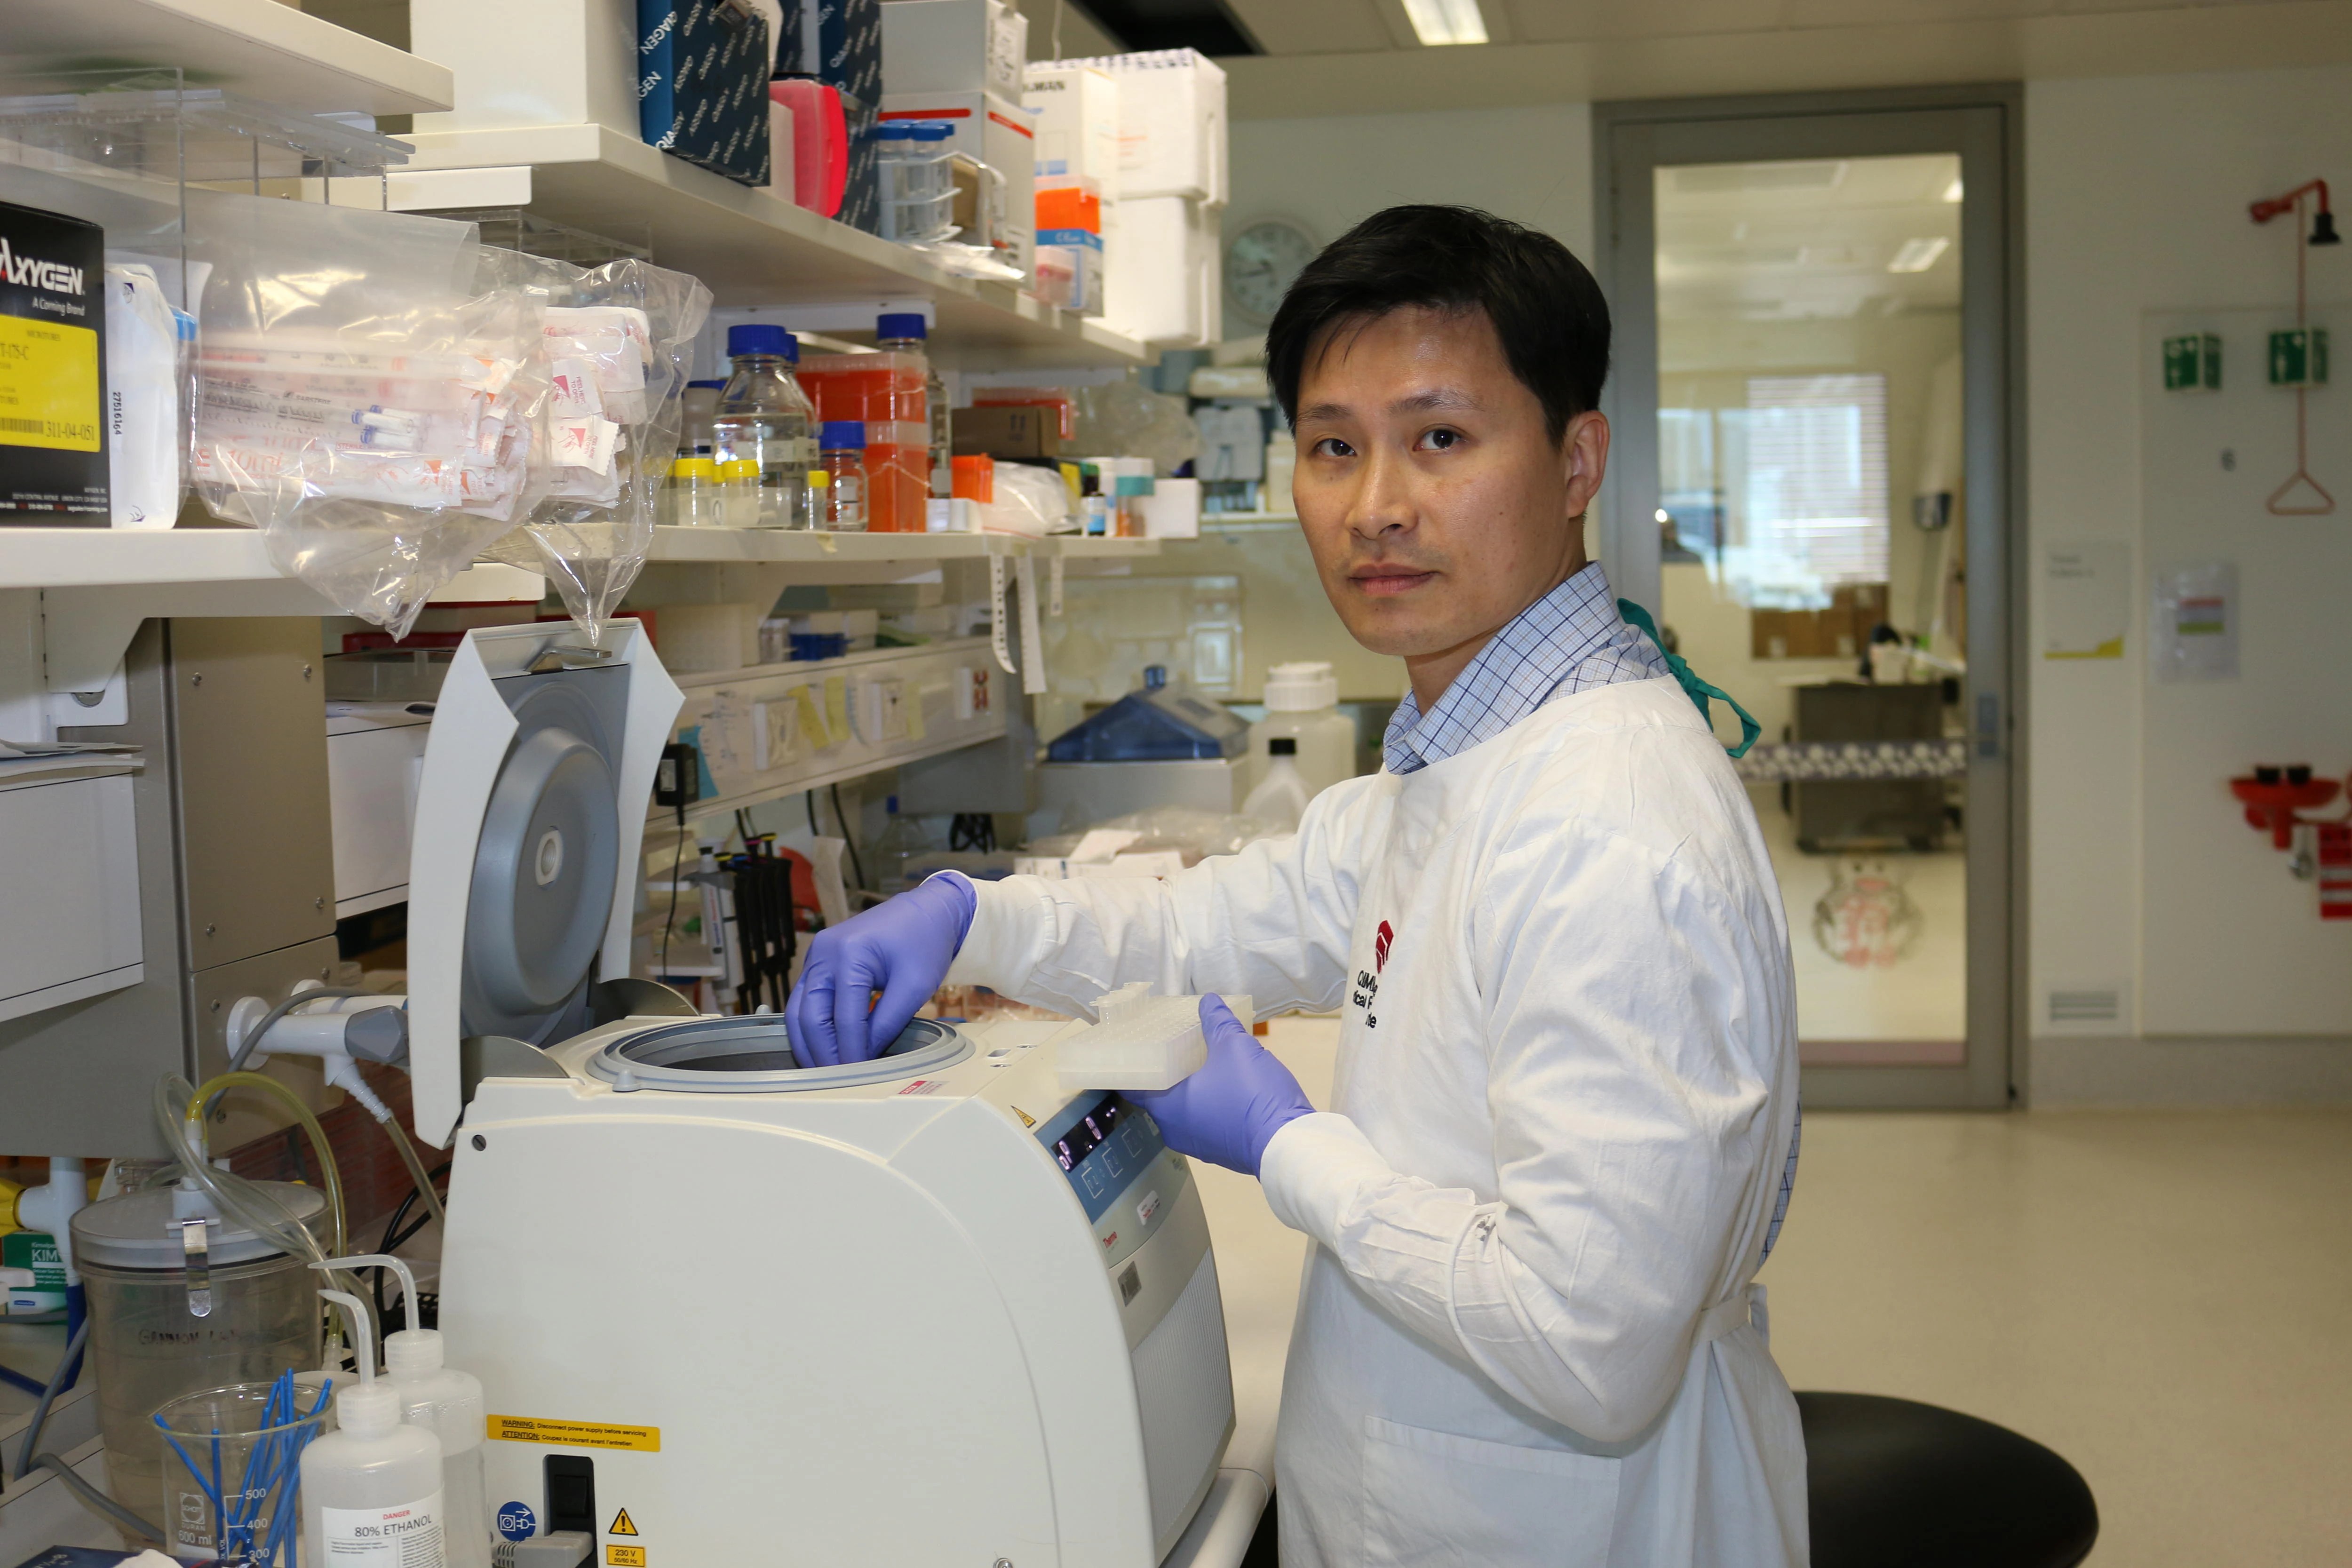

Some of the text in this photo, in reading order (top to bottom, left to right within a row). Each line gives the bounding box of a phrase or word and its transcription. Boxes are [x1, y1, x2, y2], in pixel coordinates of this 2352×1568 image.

[640, 11, 678, 55] QIAGEN
[638, 71, 662, 101] GEN
[112, 392, 122, 435] 27516164
[501, 1419, 535, 1429] WARNING:
[502, 1430, 540, 1440] ATTENTION:
[245, 1488, 266, 1499] 500
[383, 1510, 410, 1520] DANGER
[246, 1518, 268, 1529] 400
[354, 1514, 432, 1537] 80% ETHANOL
[178, 1530, 195, 1543] 600
